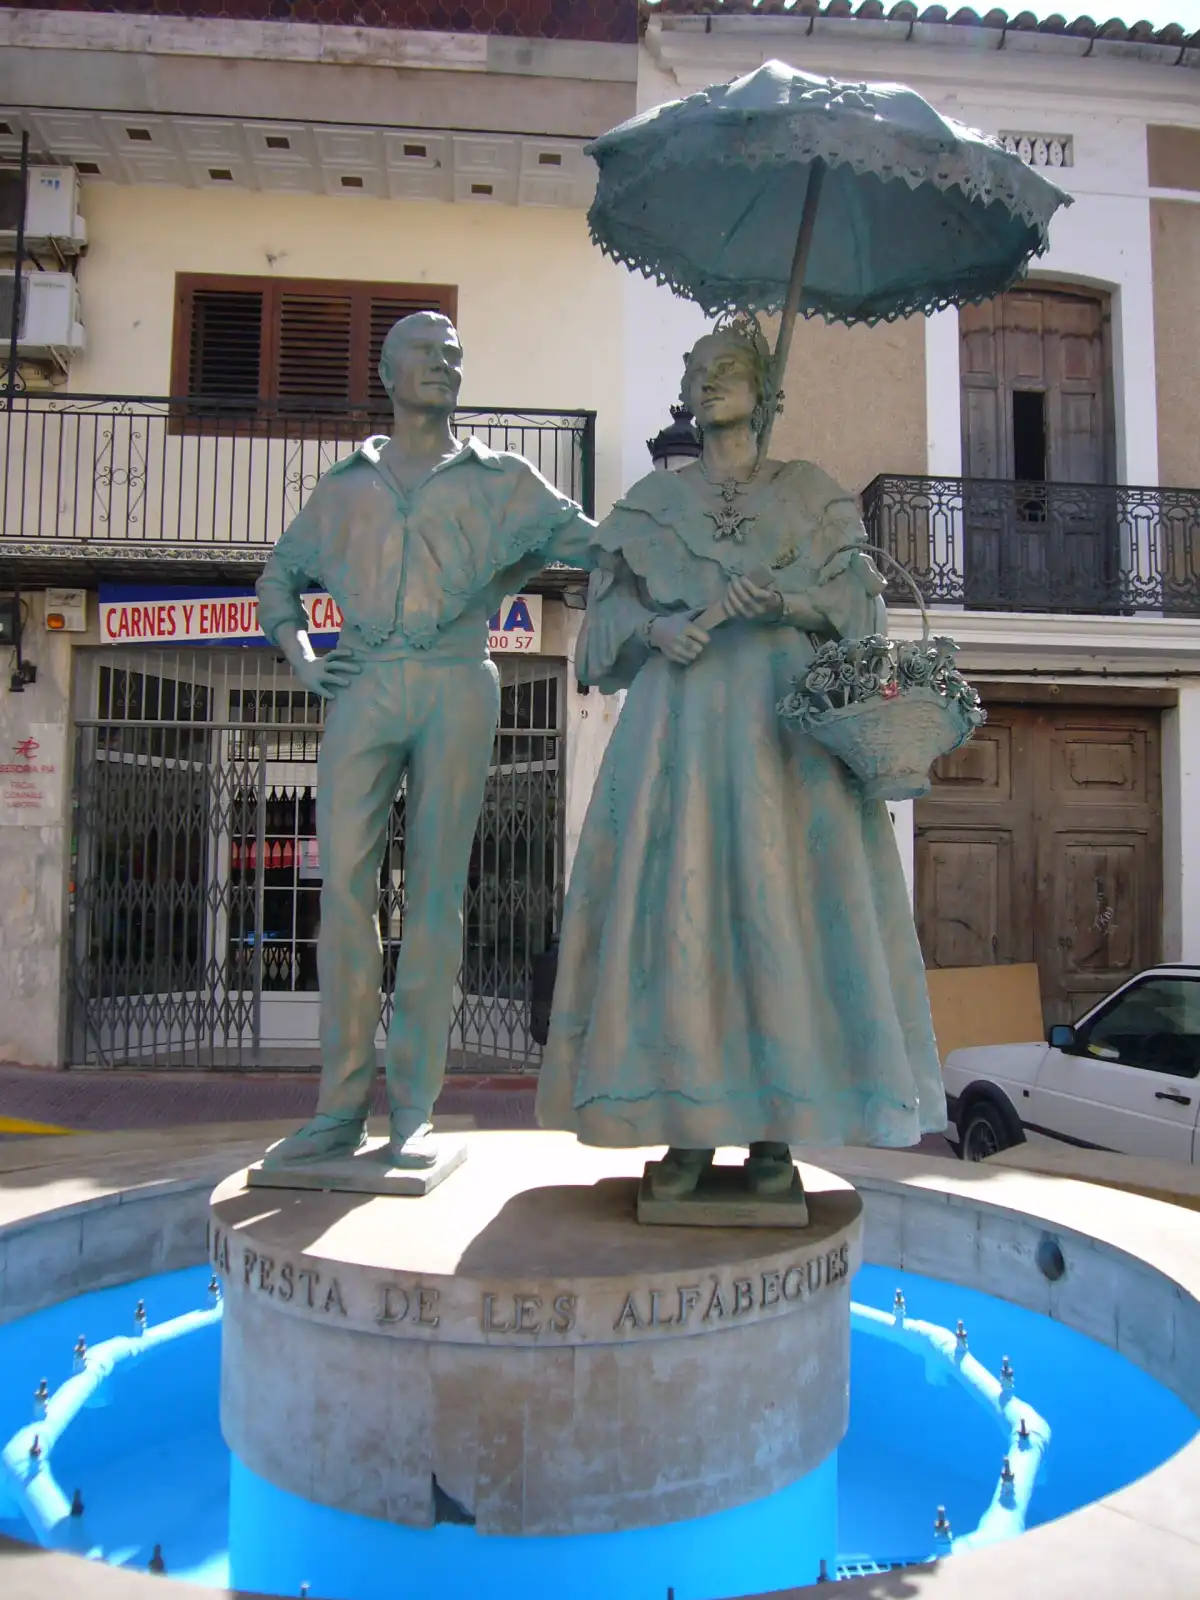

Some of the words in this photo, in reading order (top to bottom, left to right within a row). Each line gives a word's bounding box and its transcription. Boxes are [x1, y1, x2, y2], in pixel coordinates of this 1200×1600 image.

[105, 605, 177, 638] CARNES
[182, 605, 195, 634] Y
[515, 636, 533, 649] 57
[581, 709, 589, 720] 9
[243, 1247, 349, 1318] FESTA
[374, 1280, 441, 1329] DE
[479, 1291, 578, 1334] LES
[613, 1241, 850, 1332] ALFÀBEGUES
